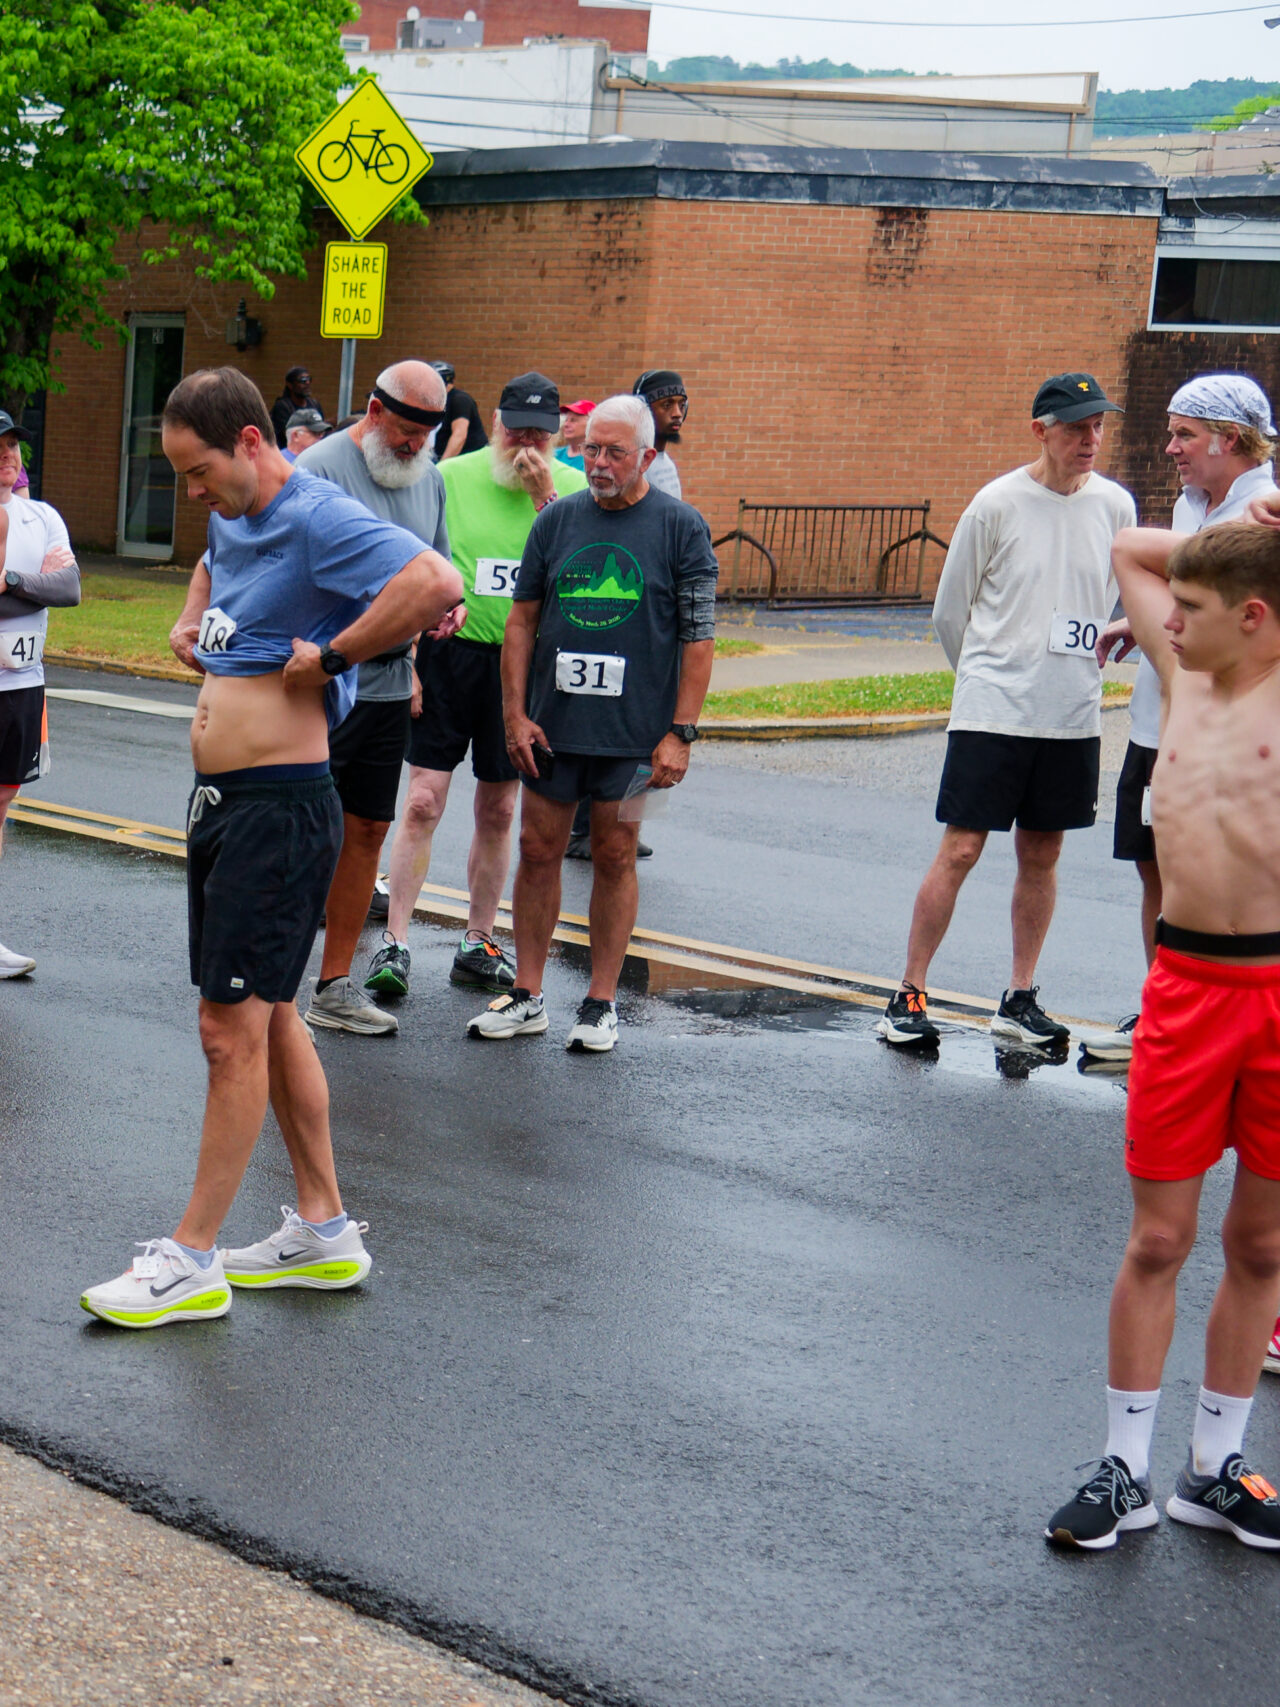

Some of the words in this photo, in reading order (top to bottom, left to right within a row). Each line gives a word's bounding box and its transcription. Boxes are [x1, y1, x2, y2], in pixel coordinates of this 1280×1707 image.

[331, 255, 380, 274] SHARE
[341, 282, 367, 299] THE
[332, 307, 372, 325] ROAD
[200, 616, 227, 653] 18
[1065, 619, 1098, 652] 30
[11, 636, 36, 662] 41
[569, 658, 609, 689] 31
